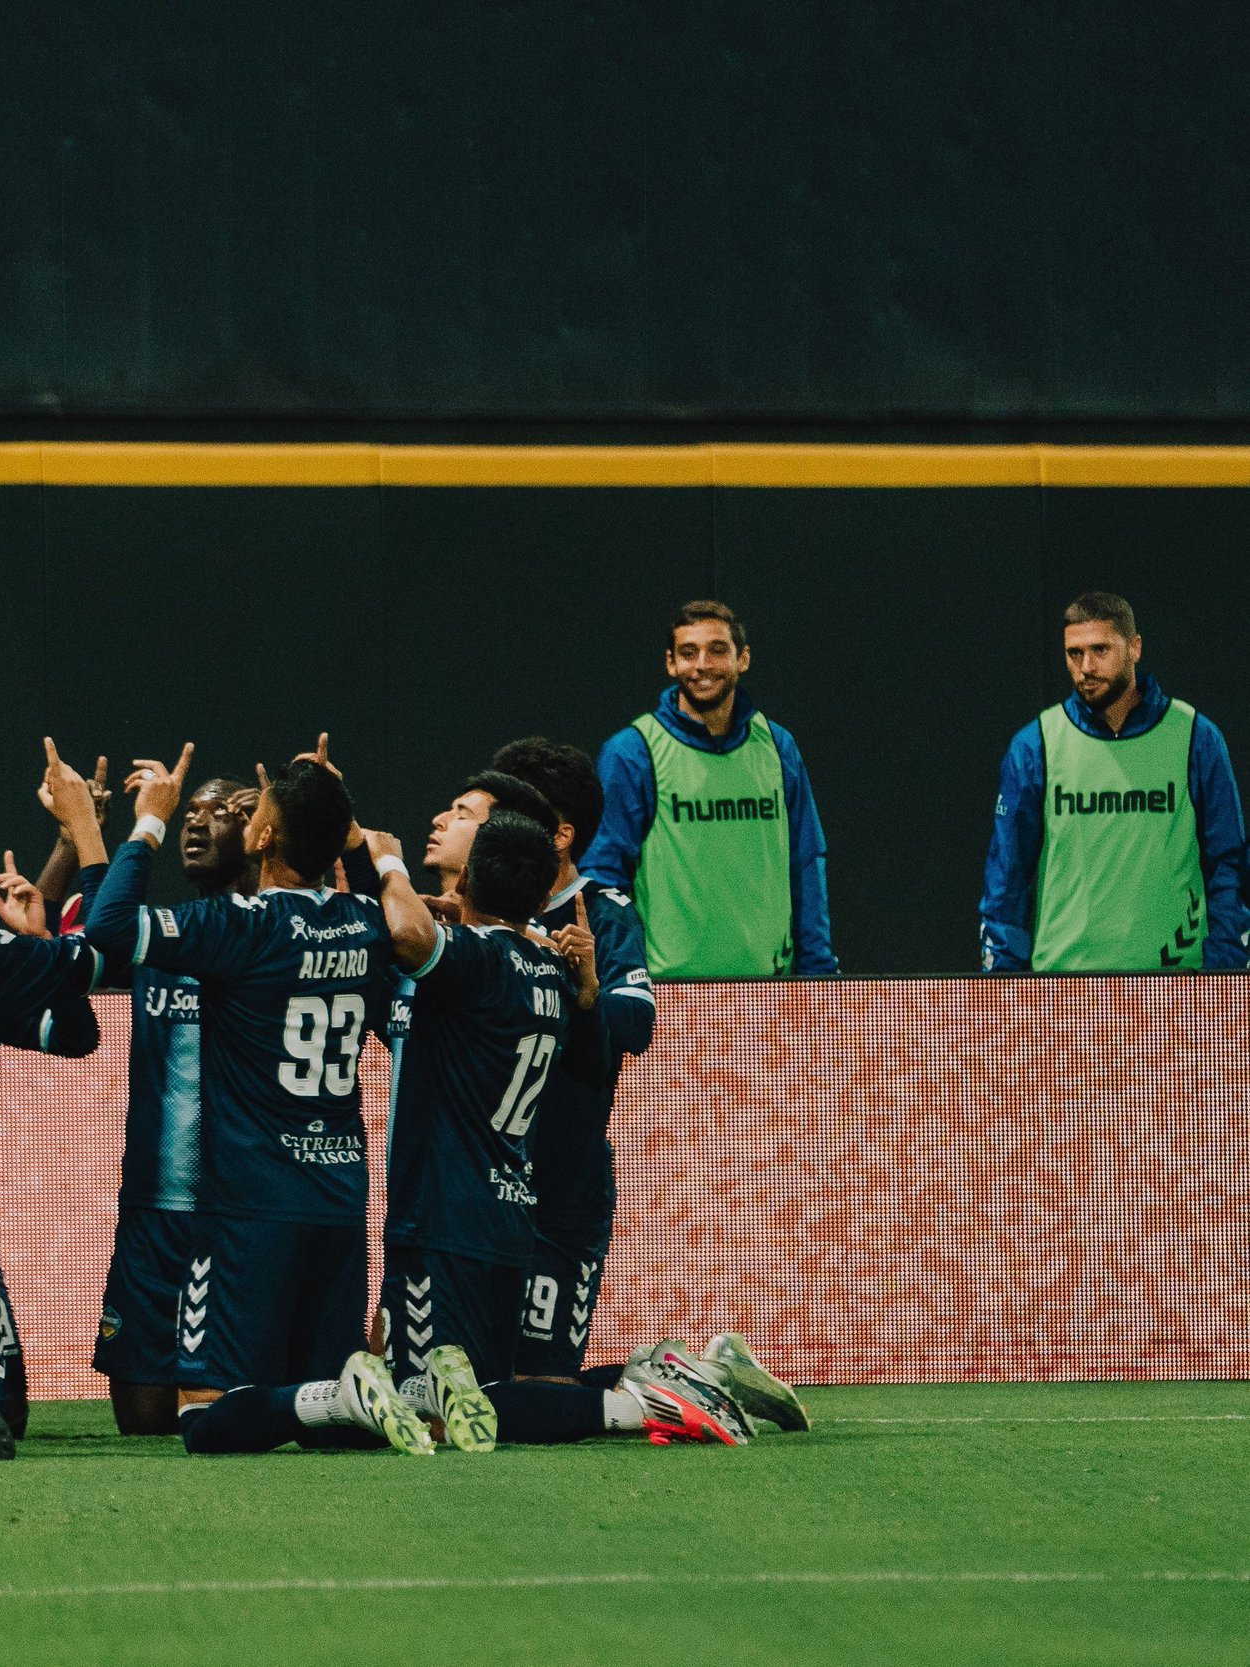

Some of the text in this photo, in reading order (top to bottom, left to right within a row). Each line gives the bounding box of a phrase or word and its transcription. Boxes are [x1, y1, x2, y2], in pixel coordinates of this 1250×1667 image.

[671, 789, 779, 823] hummel
[1054, 781, 1175, 816] hummel
[298, 948, 368, 979] ALFARO
[278, 994, 365, 1097] 93
[490, 1033, 556, 1137] 12
